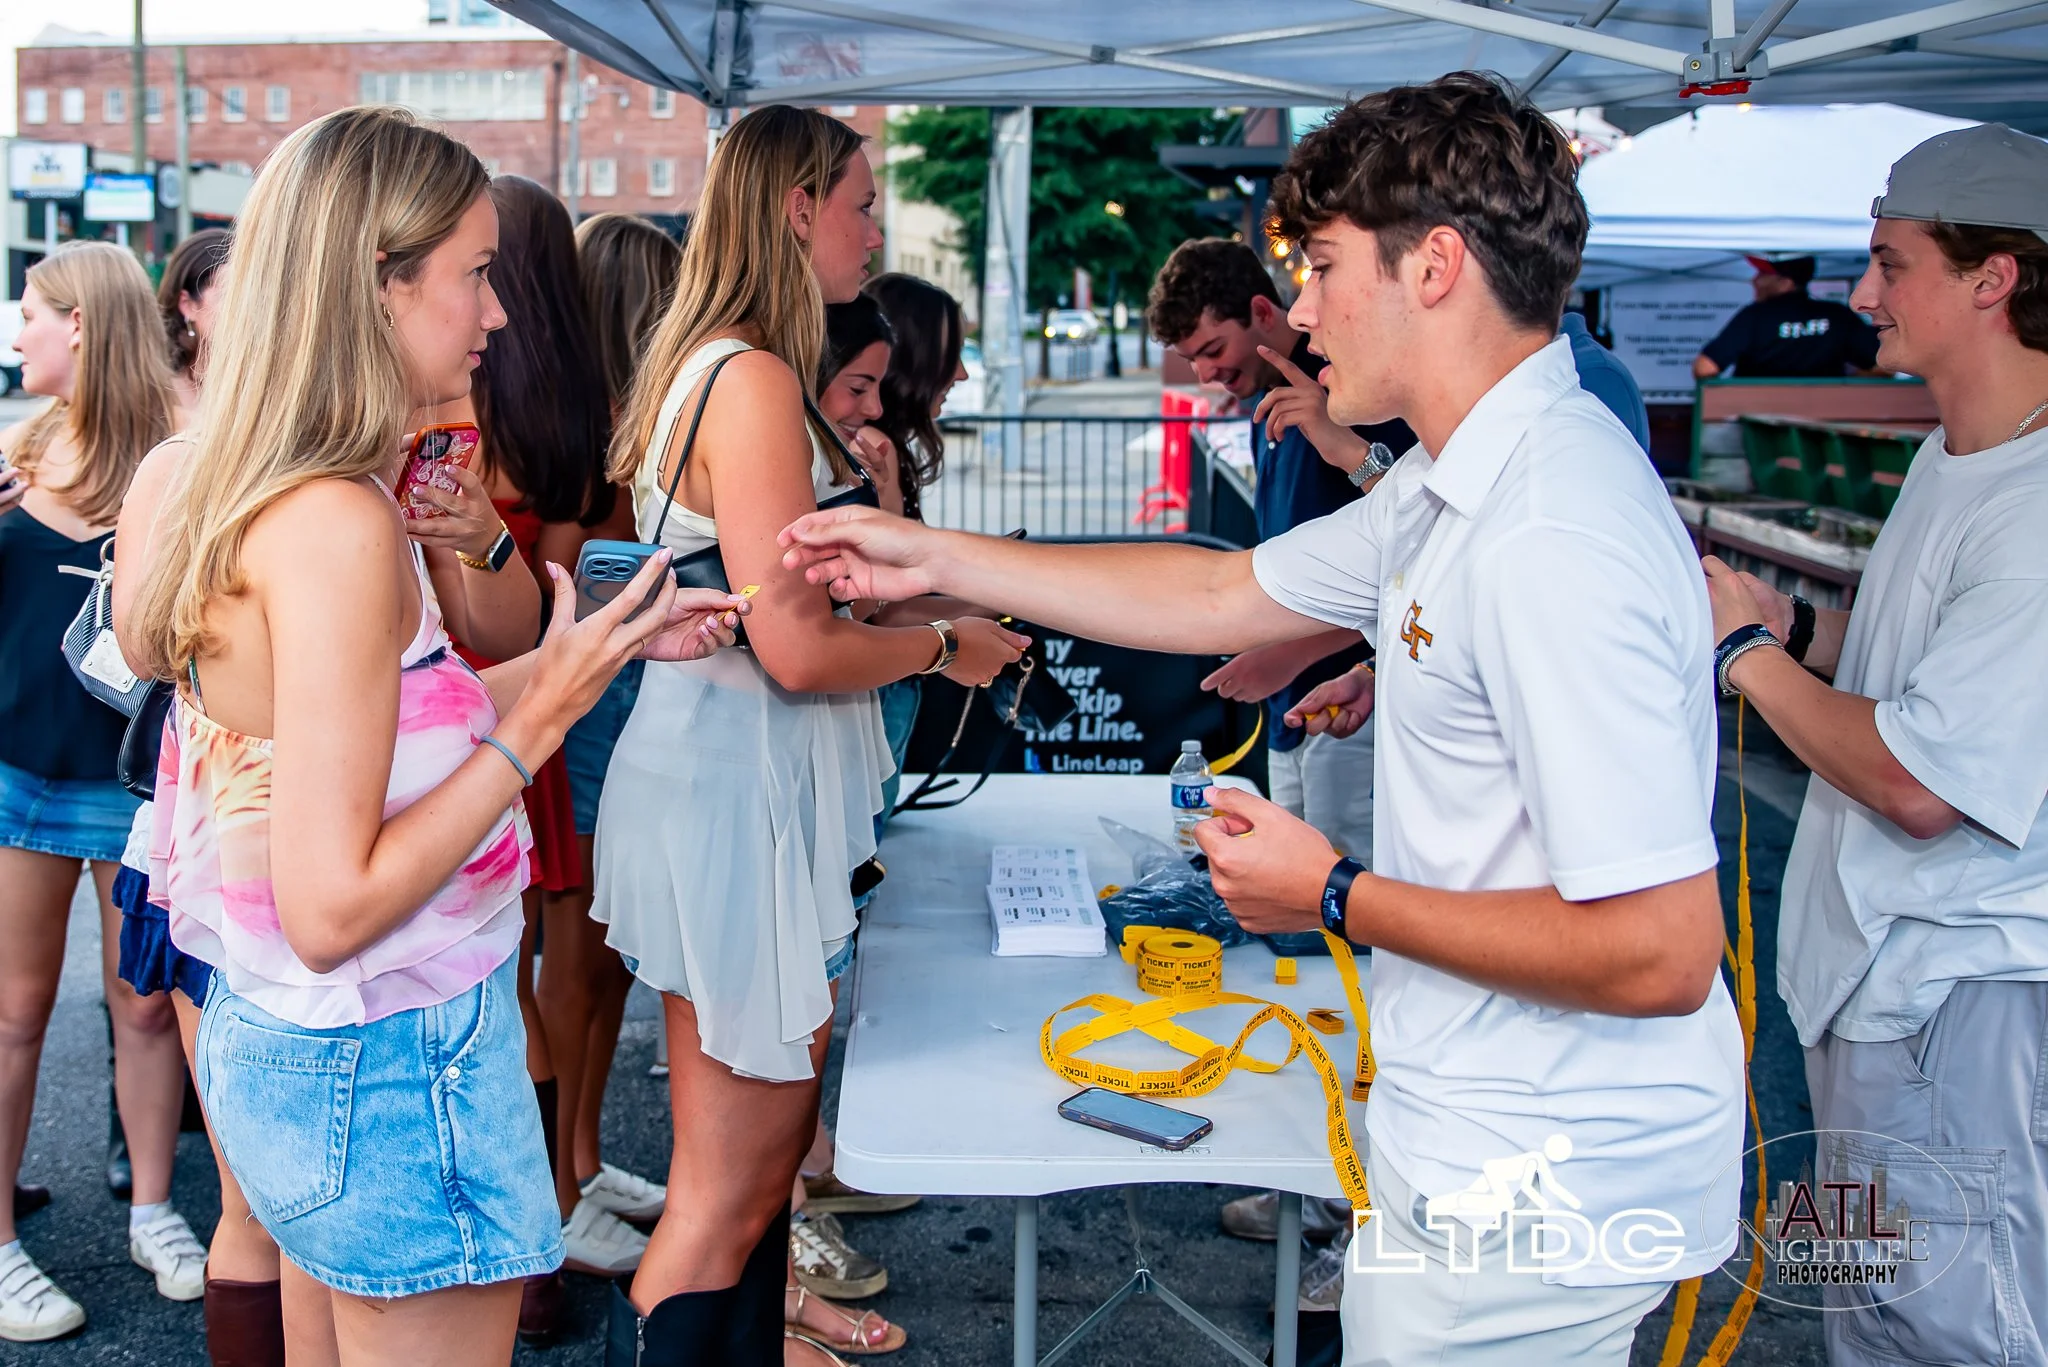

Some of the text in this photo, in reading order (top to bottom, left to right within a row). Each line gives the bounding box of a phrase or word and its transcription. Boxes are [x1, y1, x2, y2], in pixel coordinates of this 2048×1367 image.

[1046, 666, 1101, 687] ver
[1078, 716, 1143, 741] Line.
[1052, 754, 1144, 774] LineLeap
[1146, 957, 1175, 969] TICKET
[1183, 960, 1212, 969] TICKET
[1147, 981, 1172, 989] COUPON
[1246, 1007, 1273, 1030] TICKET
[1280, 1008, 1306, 1033] TICKET
[1307, 1036, 1327, 1064] TICKET
[1097, 1074, 1130, 1088] TICKET
[1140, 1081, 1175, 1089] TICKET
[1192, 1066, 1222, 1089] TICKET
[1327, 1067, 1338, 1093] TICKET
[1336, 1121, 1349, 1149] TICKET
[1344, 1154, 1366, 1192] TICKET
